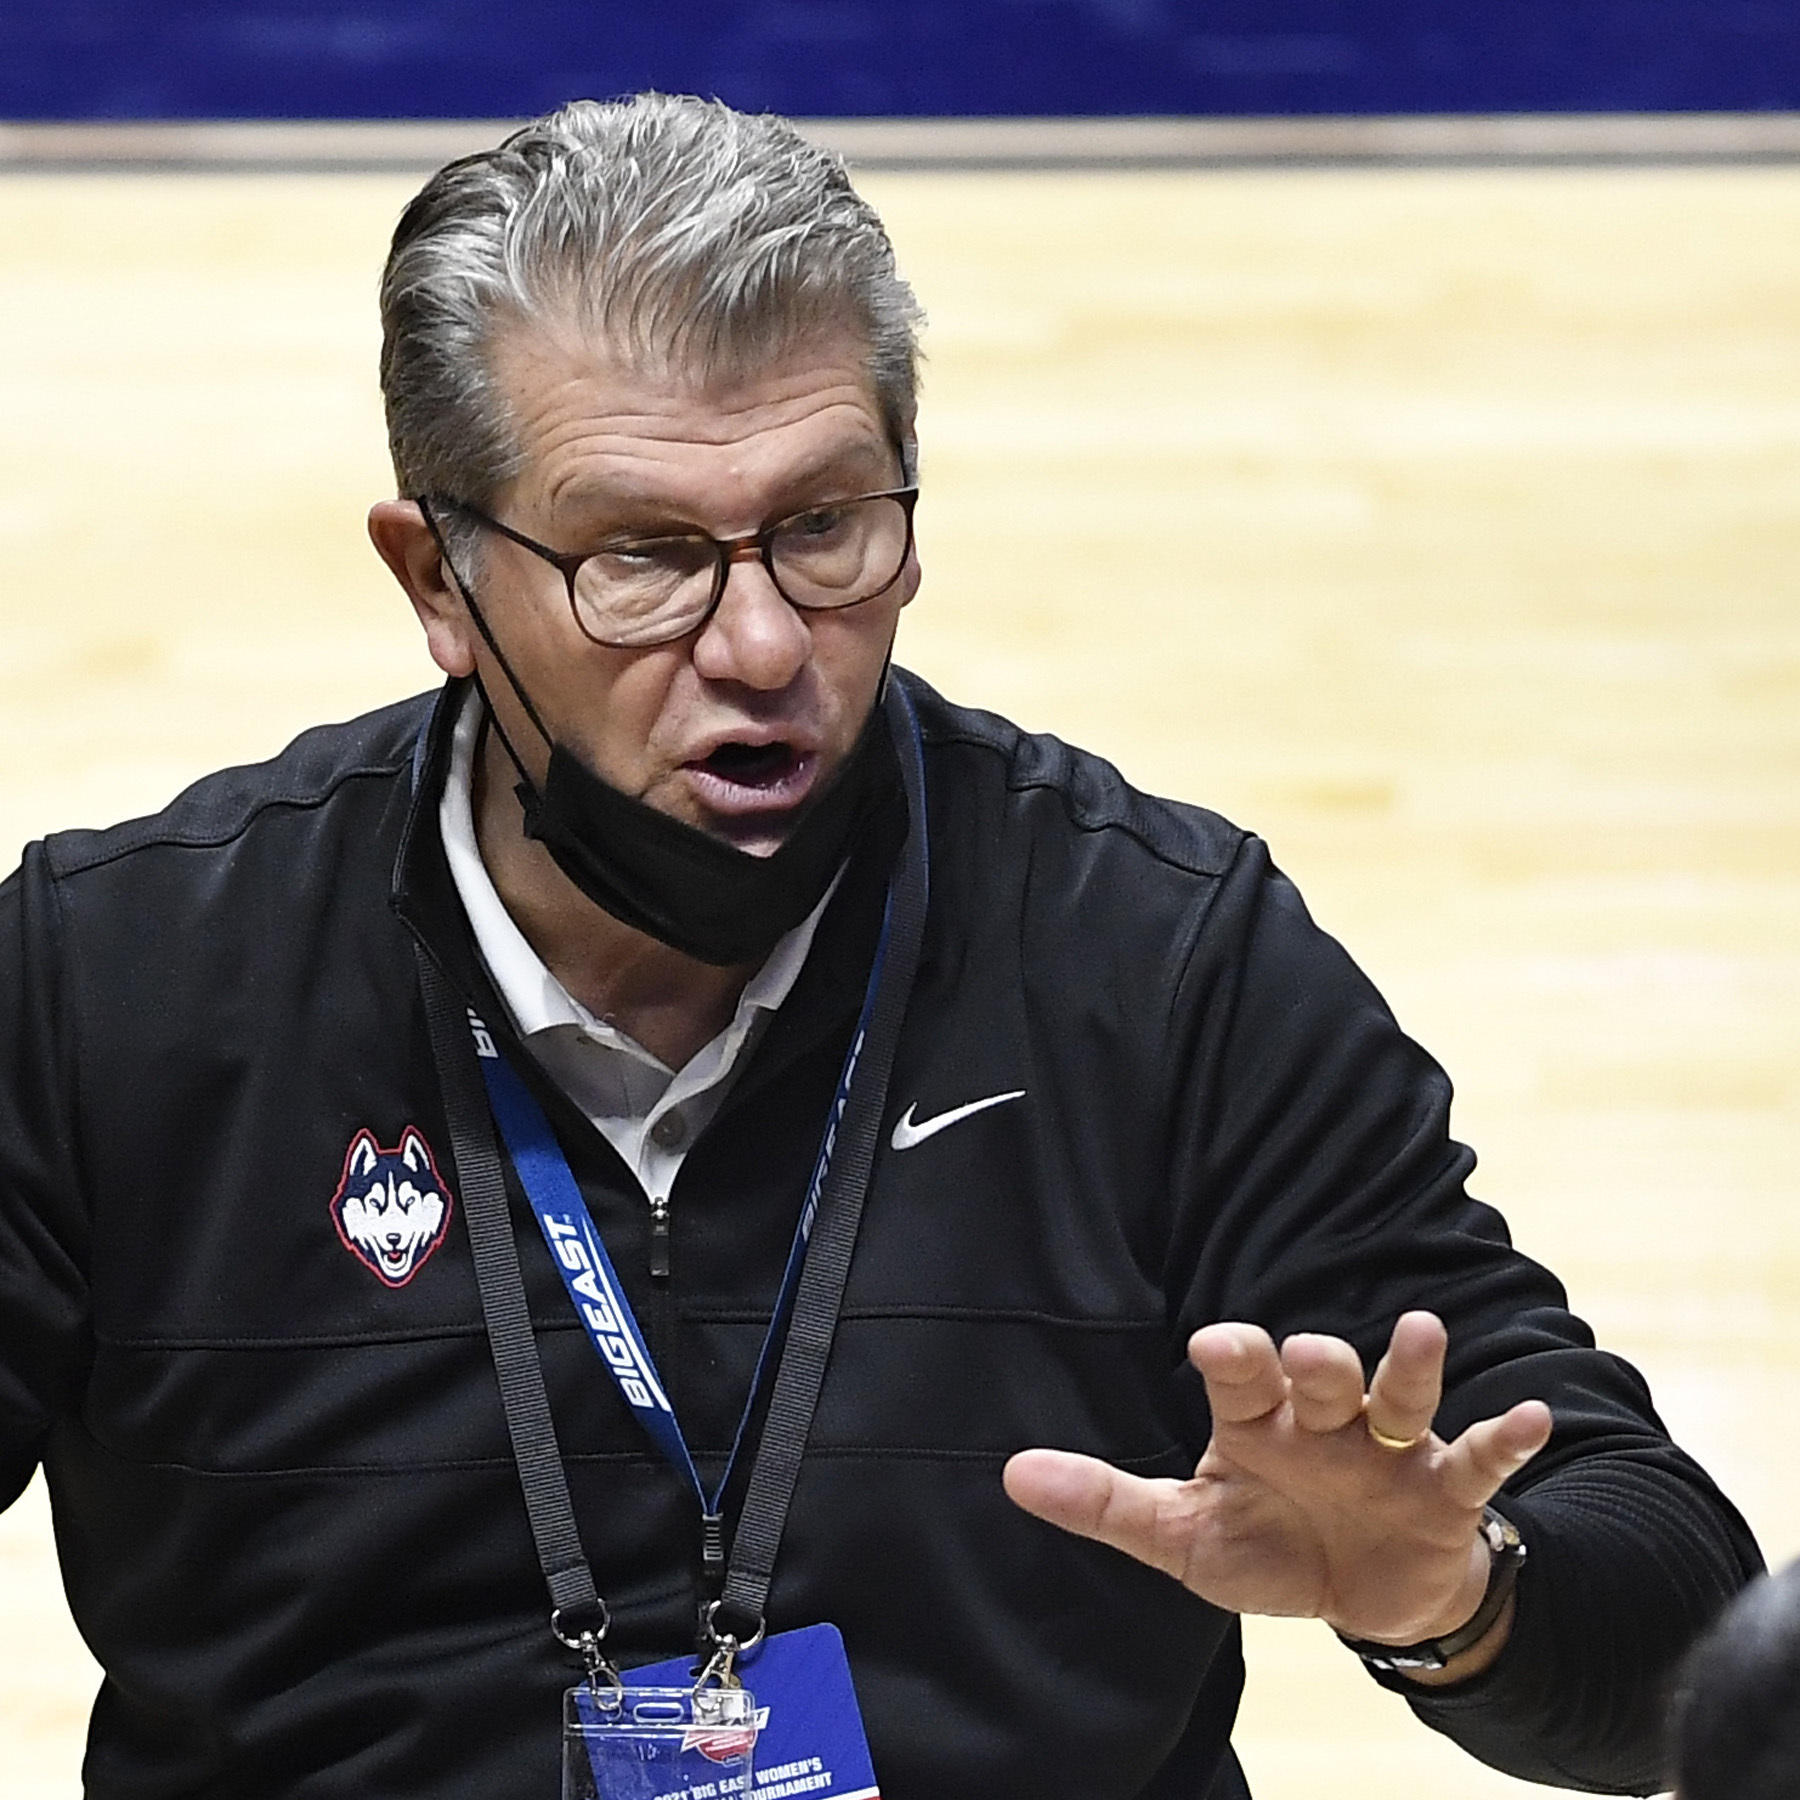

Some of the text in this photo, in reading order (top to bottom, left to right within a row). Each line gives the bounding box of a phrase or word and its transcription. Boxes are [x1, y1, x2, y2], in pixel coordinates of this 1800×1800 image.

[692, 1783, 717, 1800] BIG
[719, 1774, 751, 1793] EAS
[755, 1757, 824, 1786] WOMEN'S
